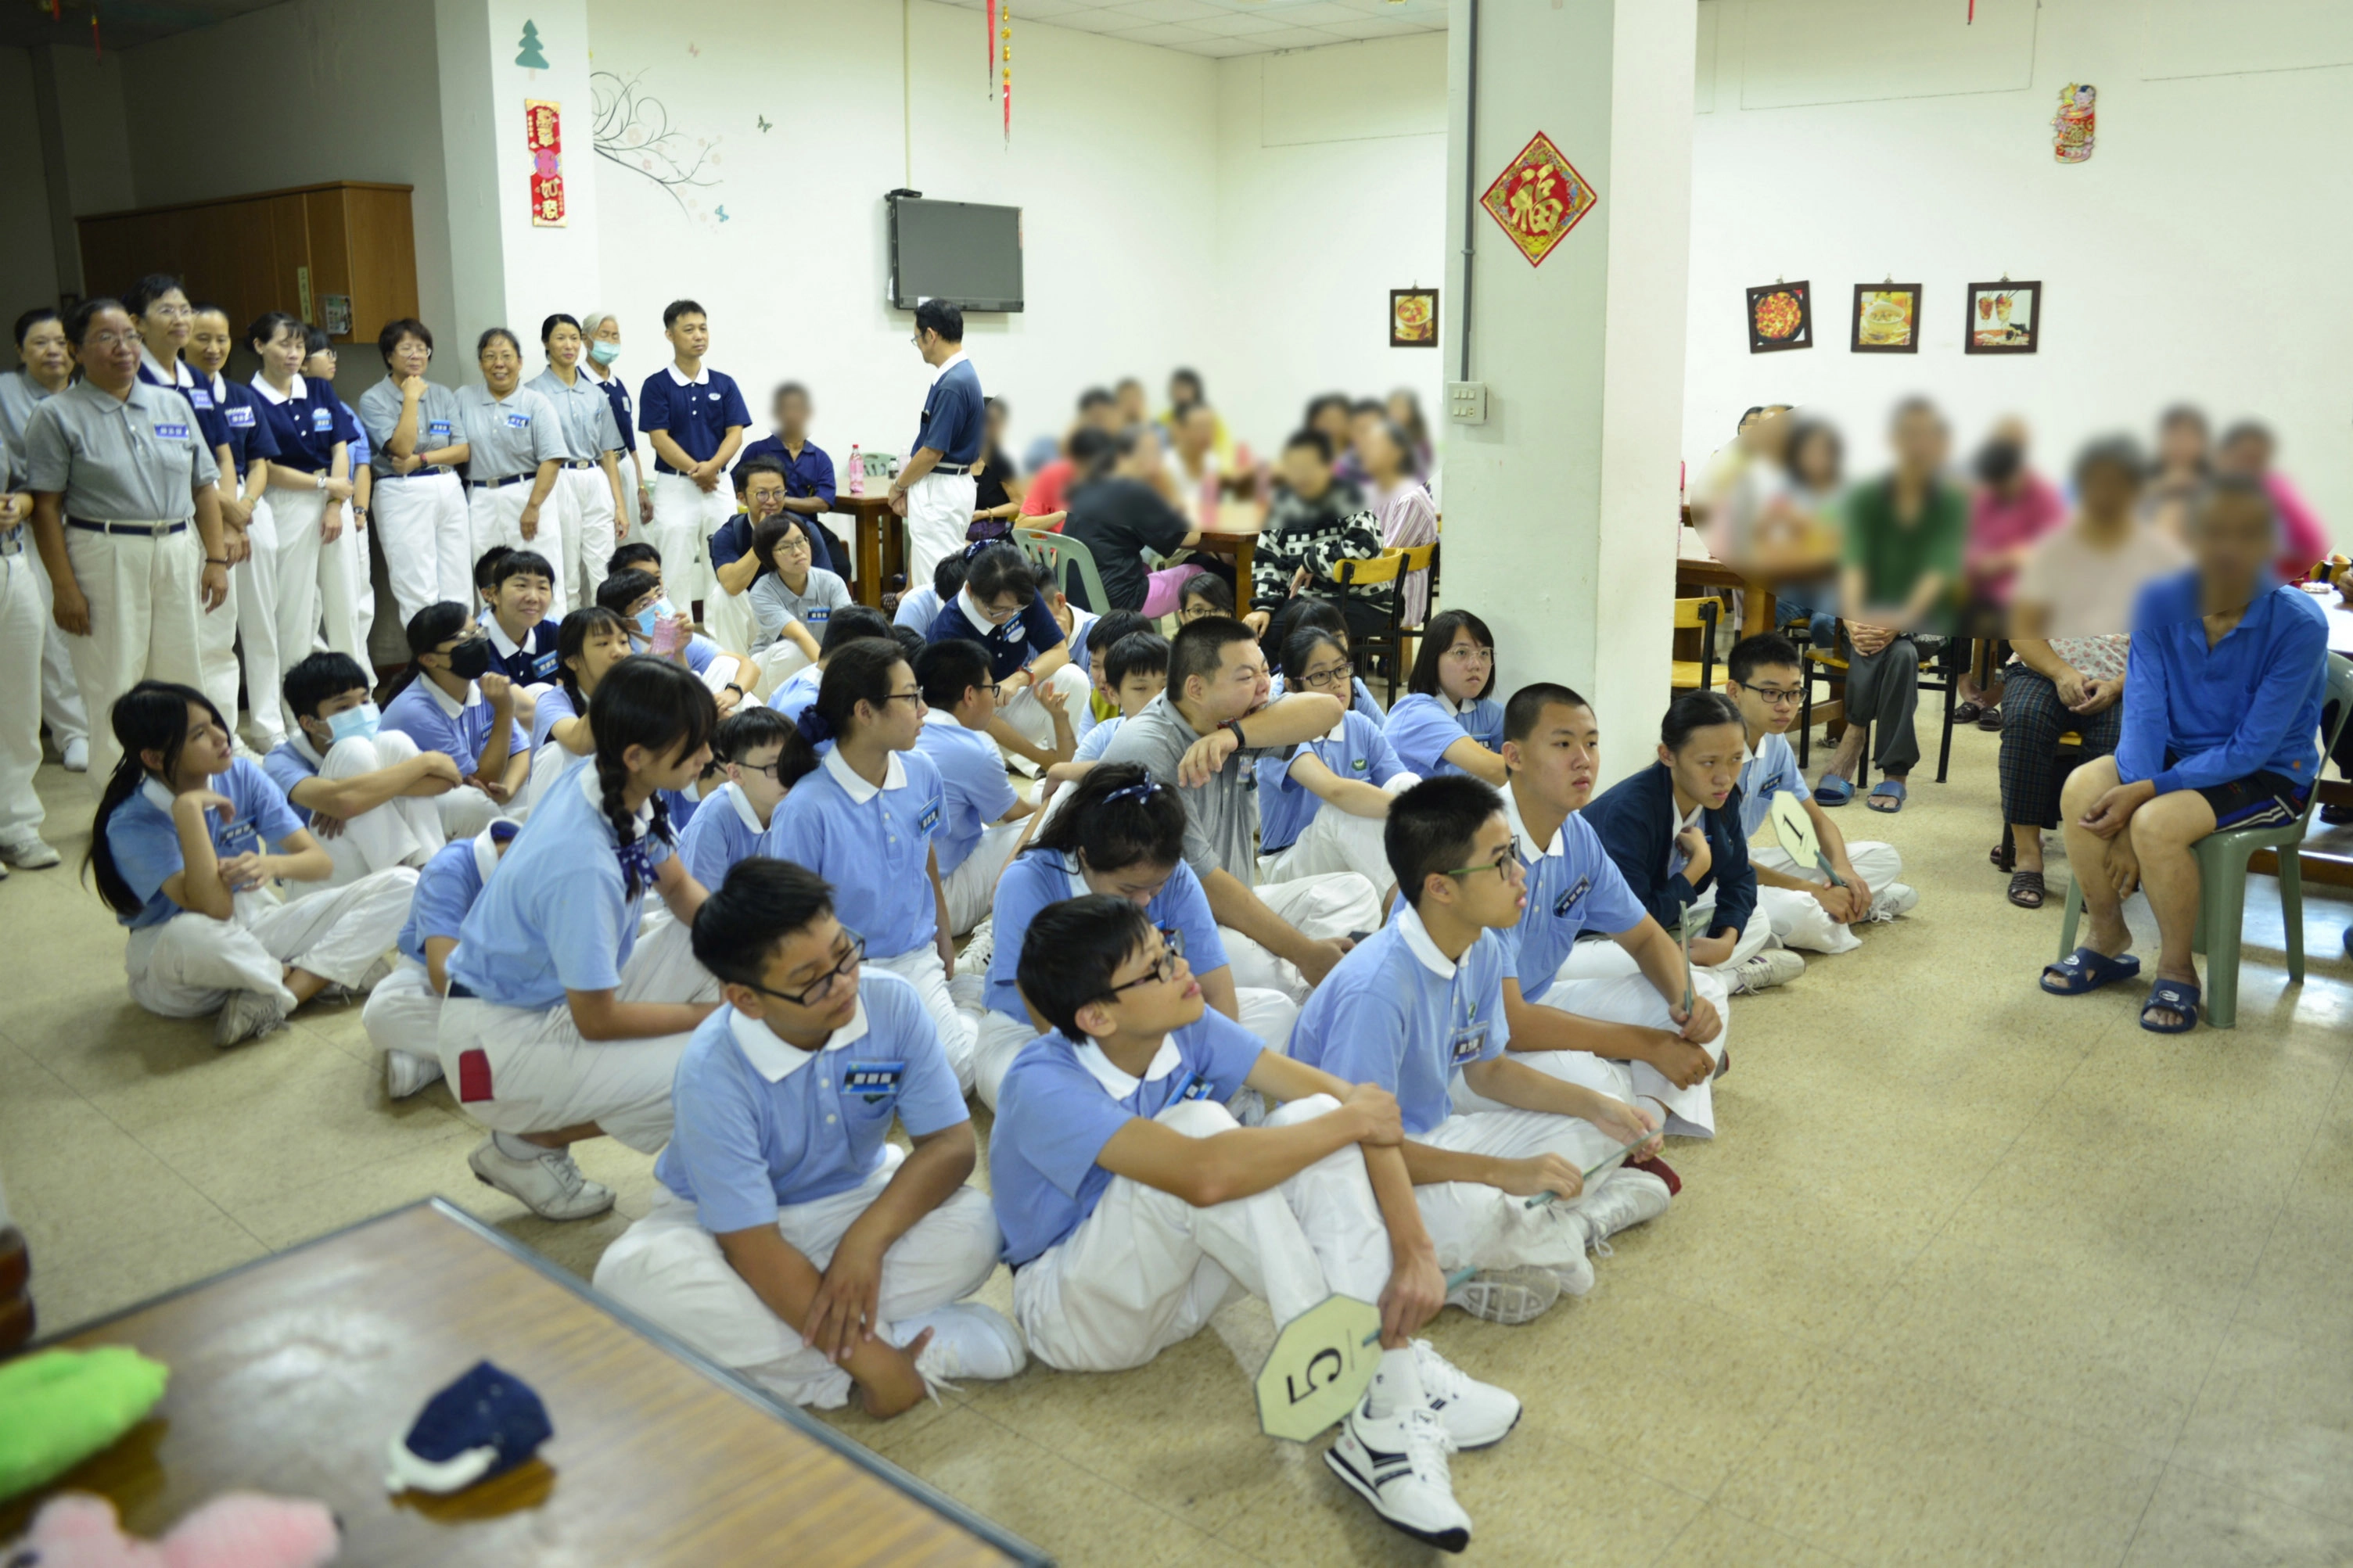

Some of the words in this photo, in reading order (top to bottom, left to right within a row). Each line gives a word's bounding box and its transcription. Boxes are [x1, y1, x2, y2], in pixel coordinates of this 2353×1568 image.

[1510, 163, 1564, 233] 福
[1783, 813, 1805, 847] 1
[1287, 1347, 1342, 1405] 5
